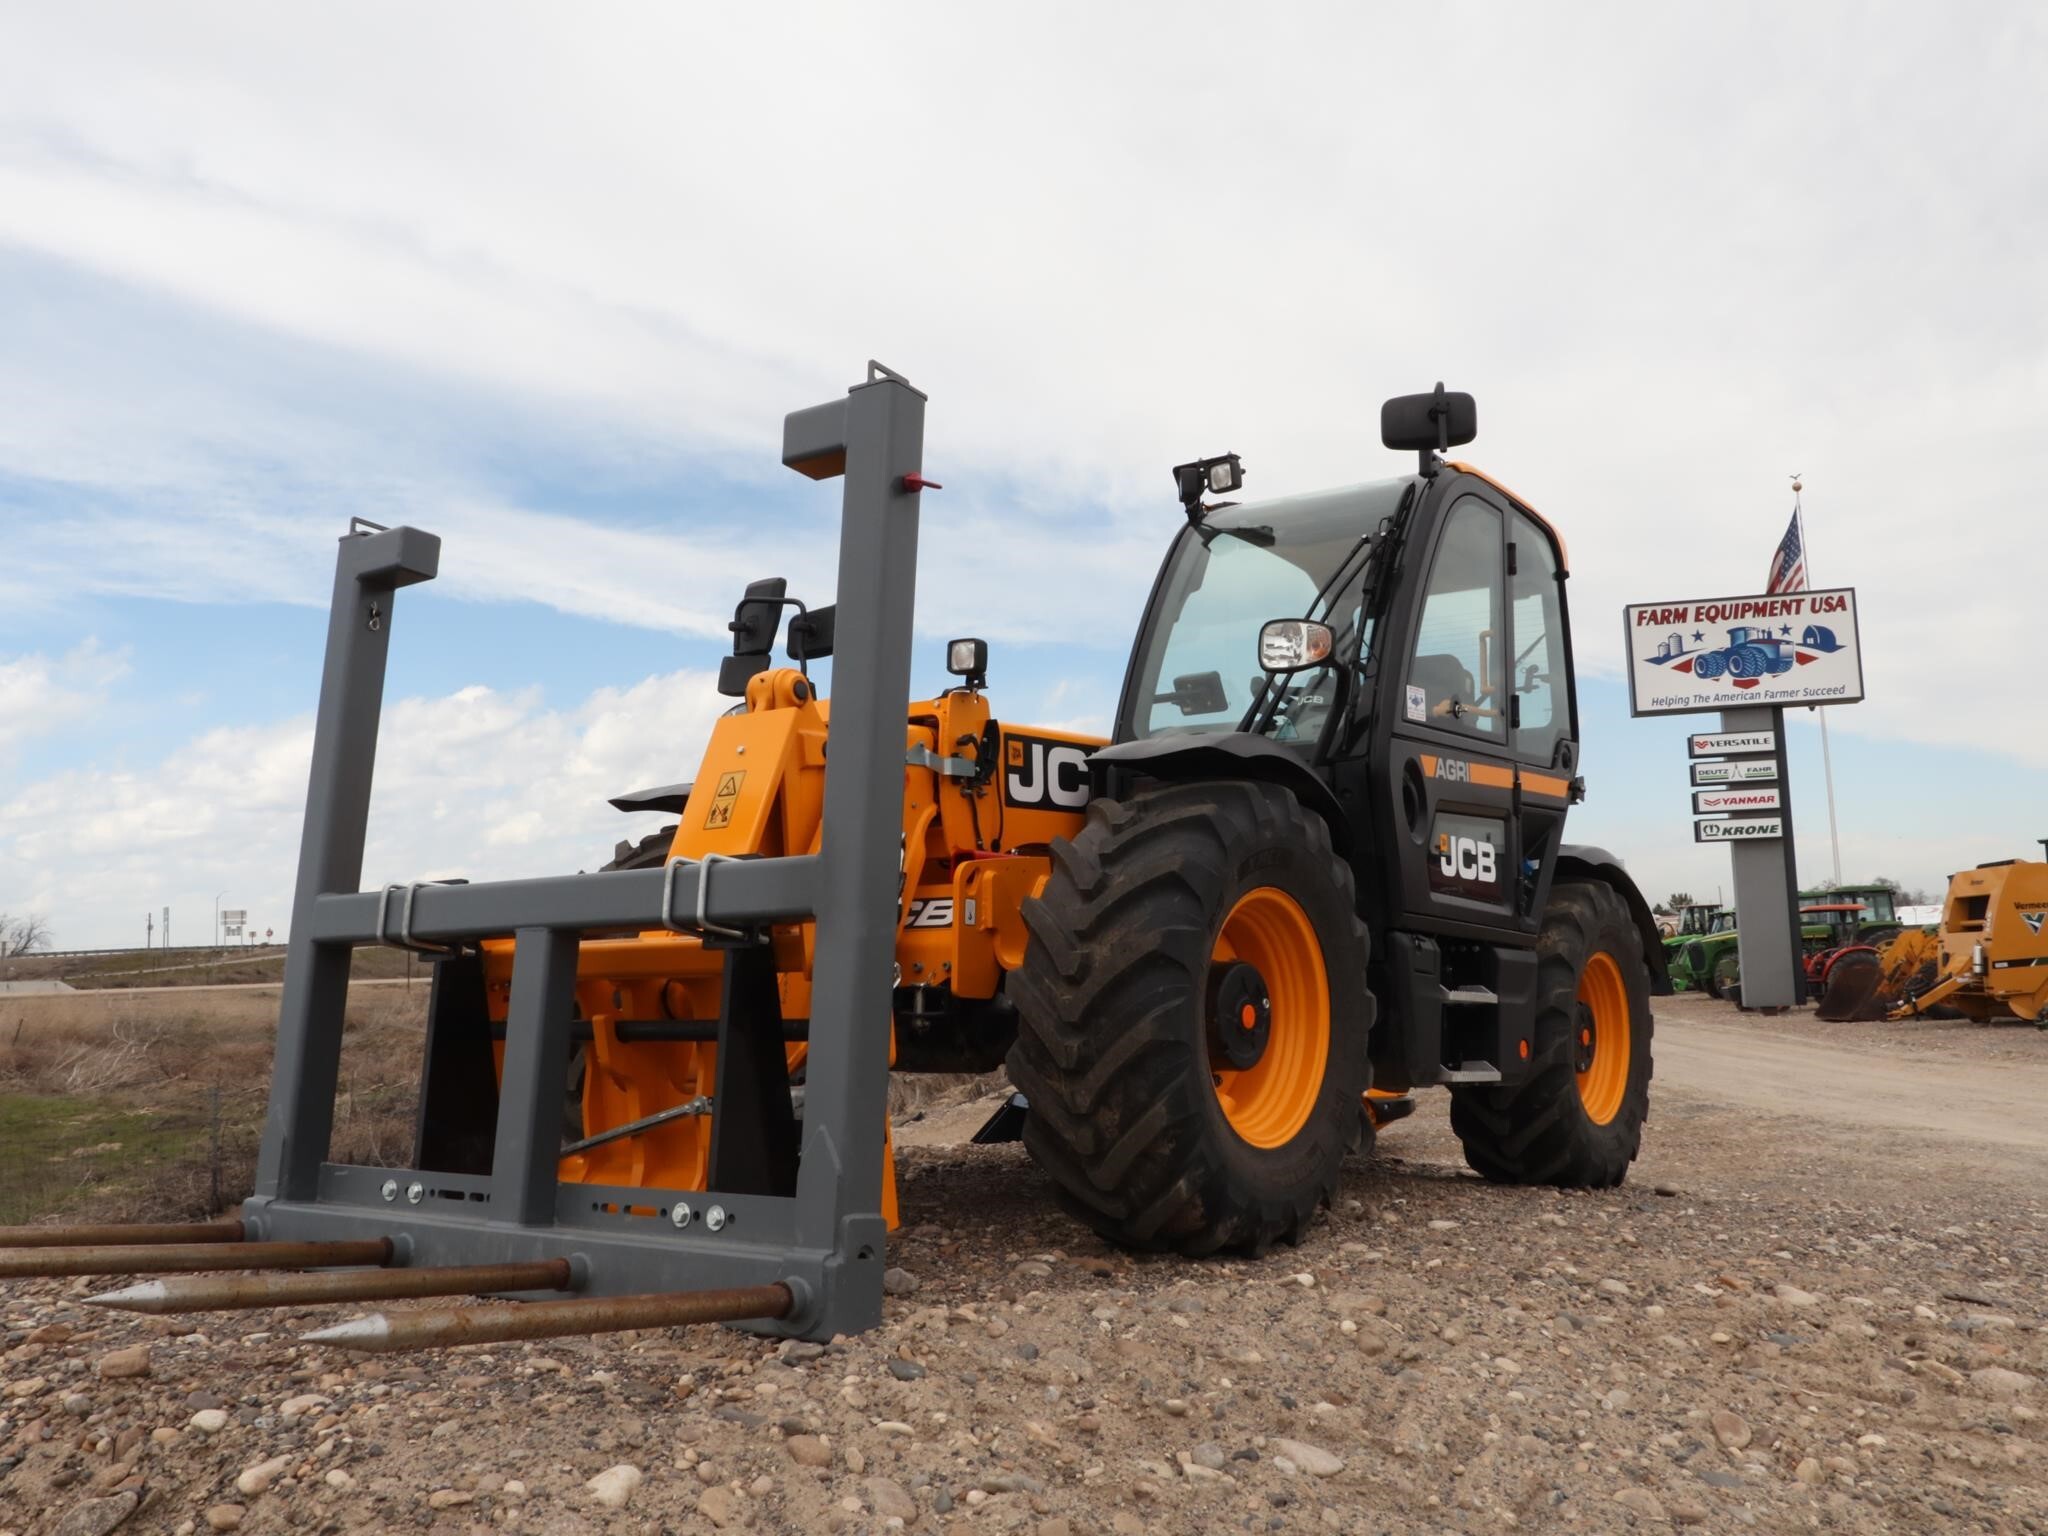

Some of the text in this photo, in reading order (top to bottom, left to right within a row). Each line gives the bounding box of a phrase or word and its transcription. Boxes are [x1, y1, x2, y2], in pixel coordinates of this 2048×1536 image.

[1637, 595, 1847, 626] FARM EQUIPMENT USA
[1652, 685, 1846, 707] Helping The American Farmer Succeed
[1709, 737, 1771, 748] VERSATILE
[1008, 743, 1089, 807] JC
[1436, 757, 1470, 783] AGRI
[1698, 768, 1729, 776] DEUTZ
[1722, 795, 1775, 806] YANMAR
[1722, 824, 1779, 836] KRONE
[1440, 835, 1496, 883] JCB
[2013, 902, 2048, 910] Vermee
